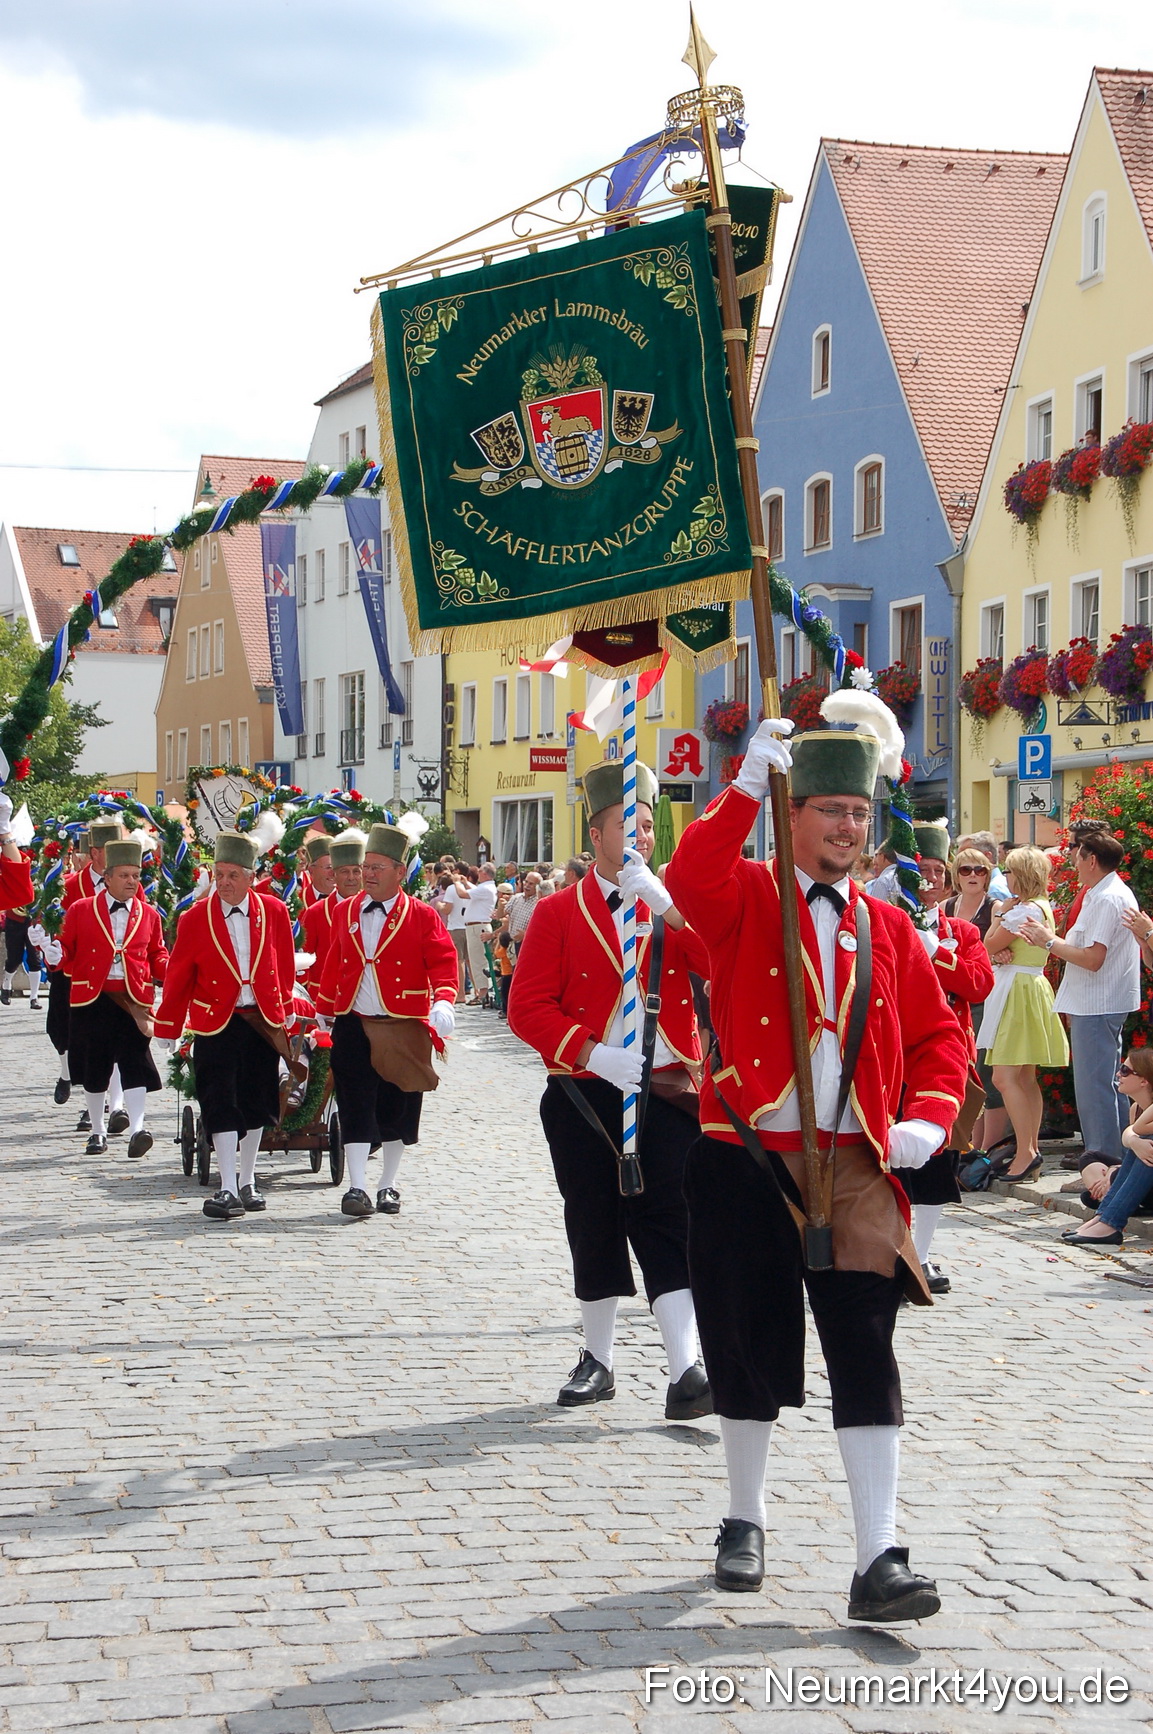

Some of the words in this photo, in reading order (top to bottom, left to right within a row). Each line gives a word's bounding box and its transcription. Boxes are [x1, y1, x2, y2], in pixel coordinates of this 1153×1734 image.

[731, 222, 759, 238] 2010
[456, 306, 547, 386] Neumarkter
[554, 298, 650, 350] Lammsbräu
[617, 446, 651, 461] 1628
[485, 467, 528, 492] ANNO
[453, 455, 694, 565] SCHÄFFLERTANZGRUPPE
[930, 639, 949, 656] CAFÉ
[930, 660, 948, 746] WITTL
[531, 755, 568, 765] WISSMAC
[1026, 741, 1044, 775] P
[496, 771, 537, 789] Restaurant
